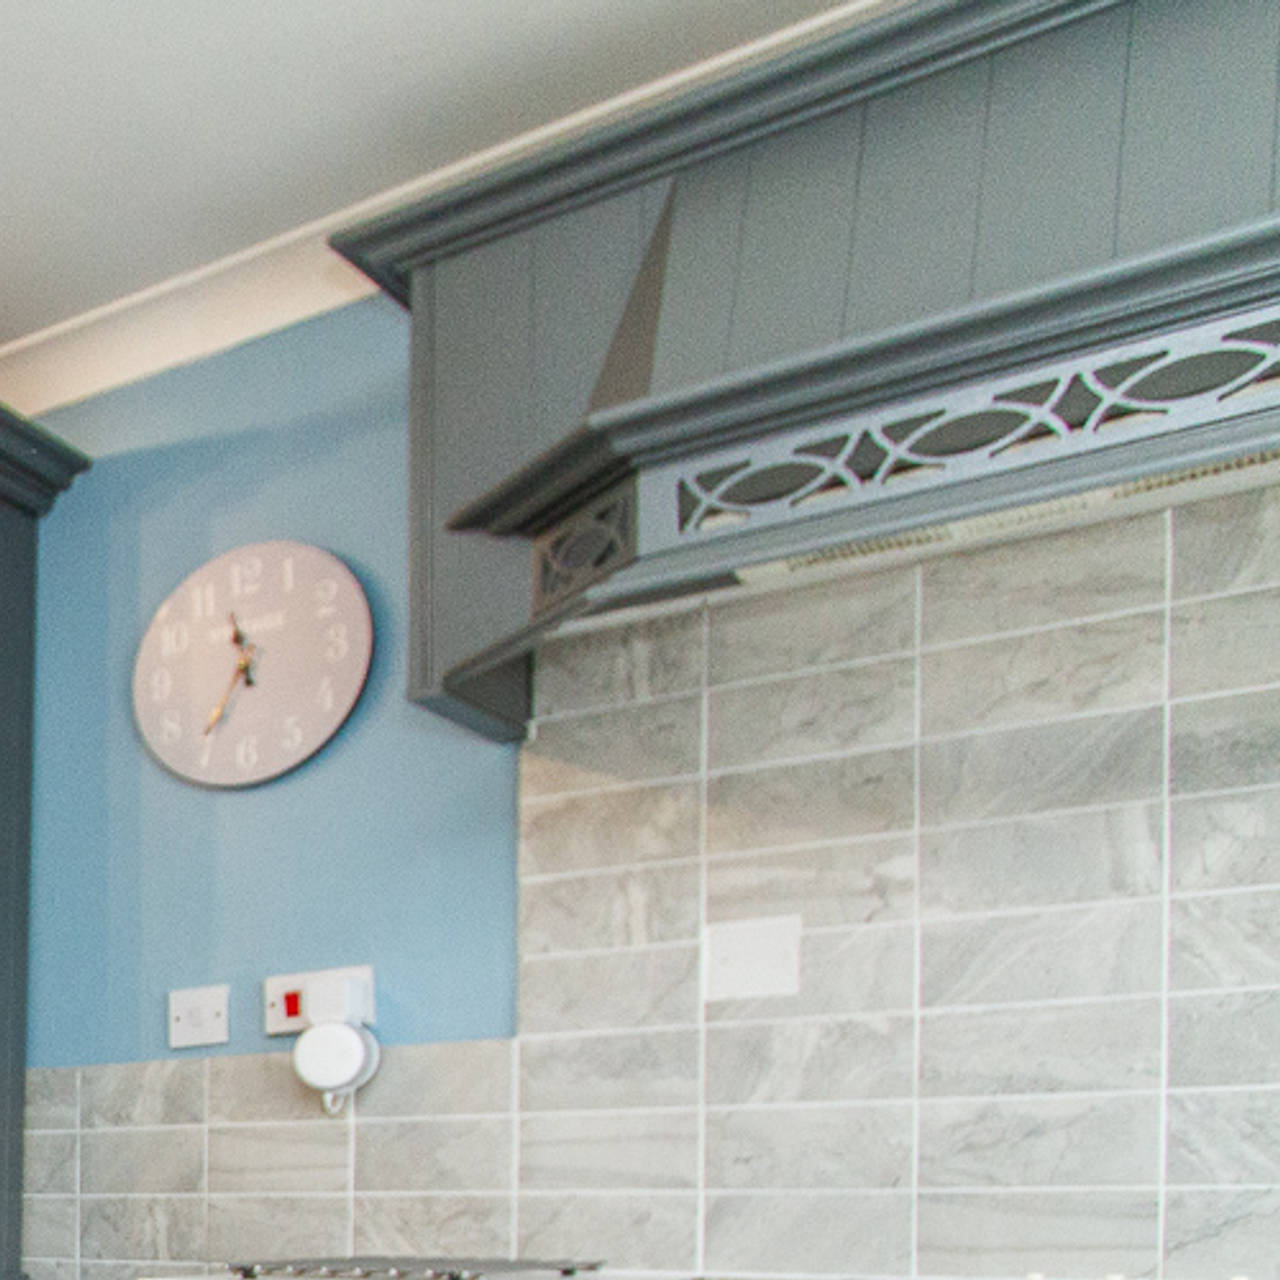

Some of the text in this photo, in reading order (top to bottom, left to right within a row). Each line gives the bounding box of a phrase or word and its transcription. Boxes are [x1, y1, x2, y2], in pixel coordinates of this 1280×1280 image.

[229, 557, 264, 596] 12
[282, 556, 294, 592] 1
[191, 582, 215, 619] 11
[315, 578, 338, 618] 2
[160, 622, 189, 658] 10
[325, 623, 349, 663] 3
[149, 667, 172, 702] 9
[318, 676, 333, 712] 4
[160, 709, 182, 744] 8
[279, 715, 303, 749] 5
[235, 736, 258, 769] 6
